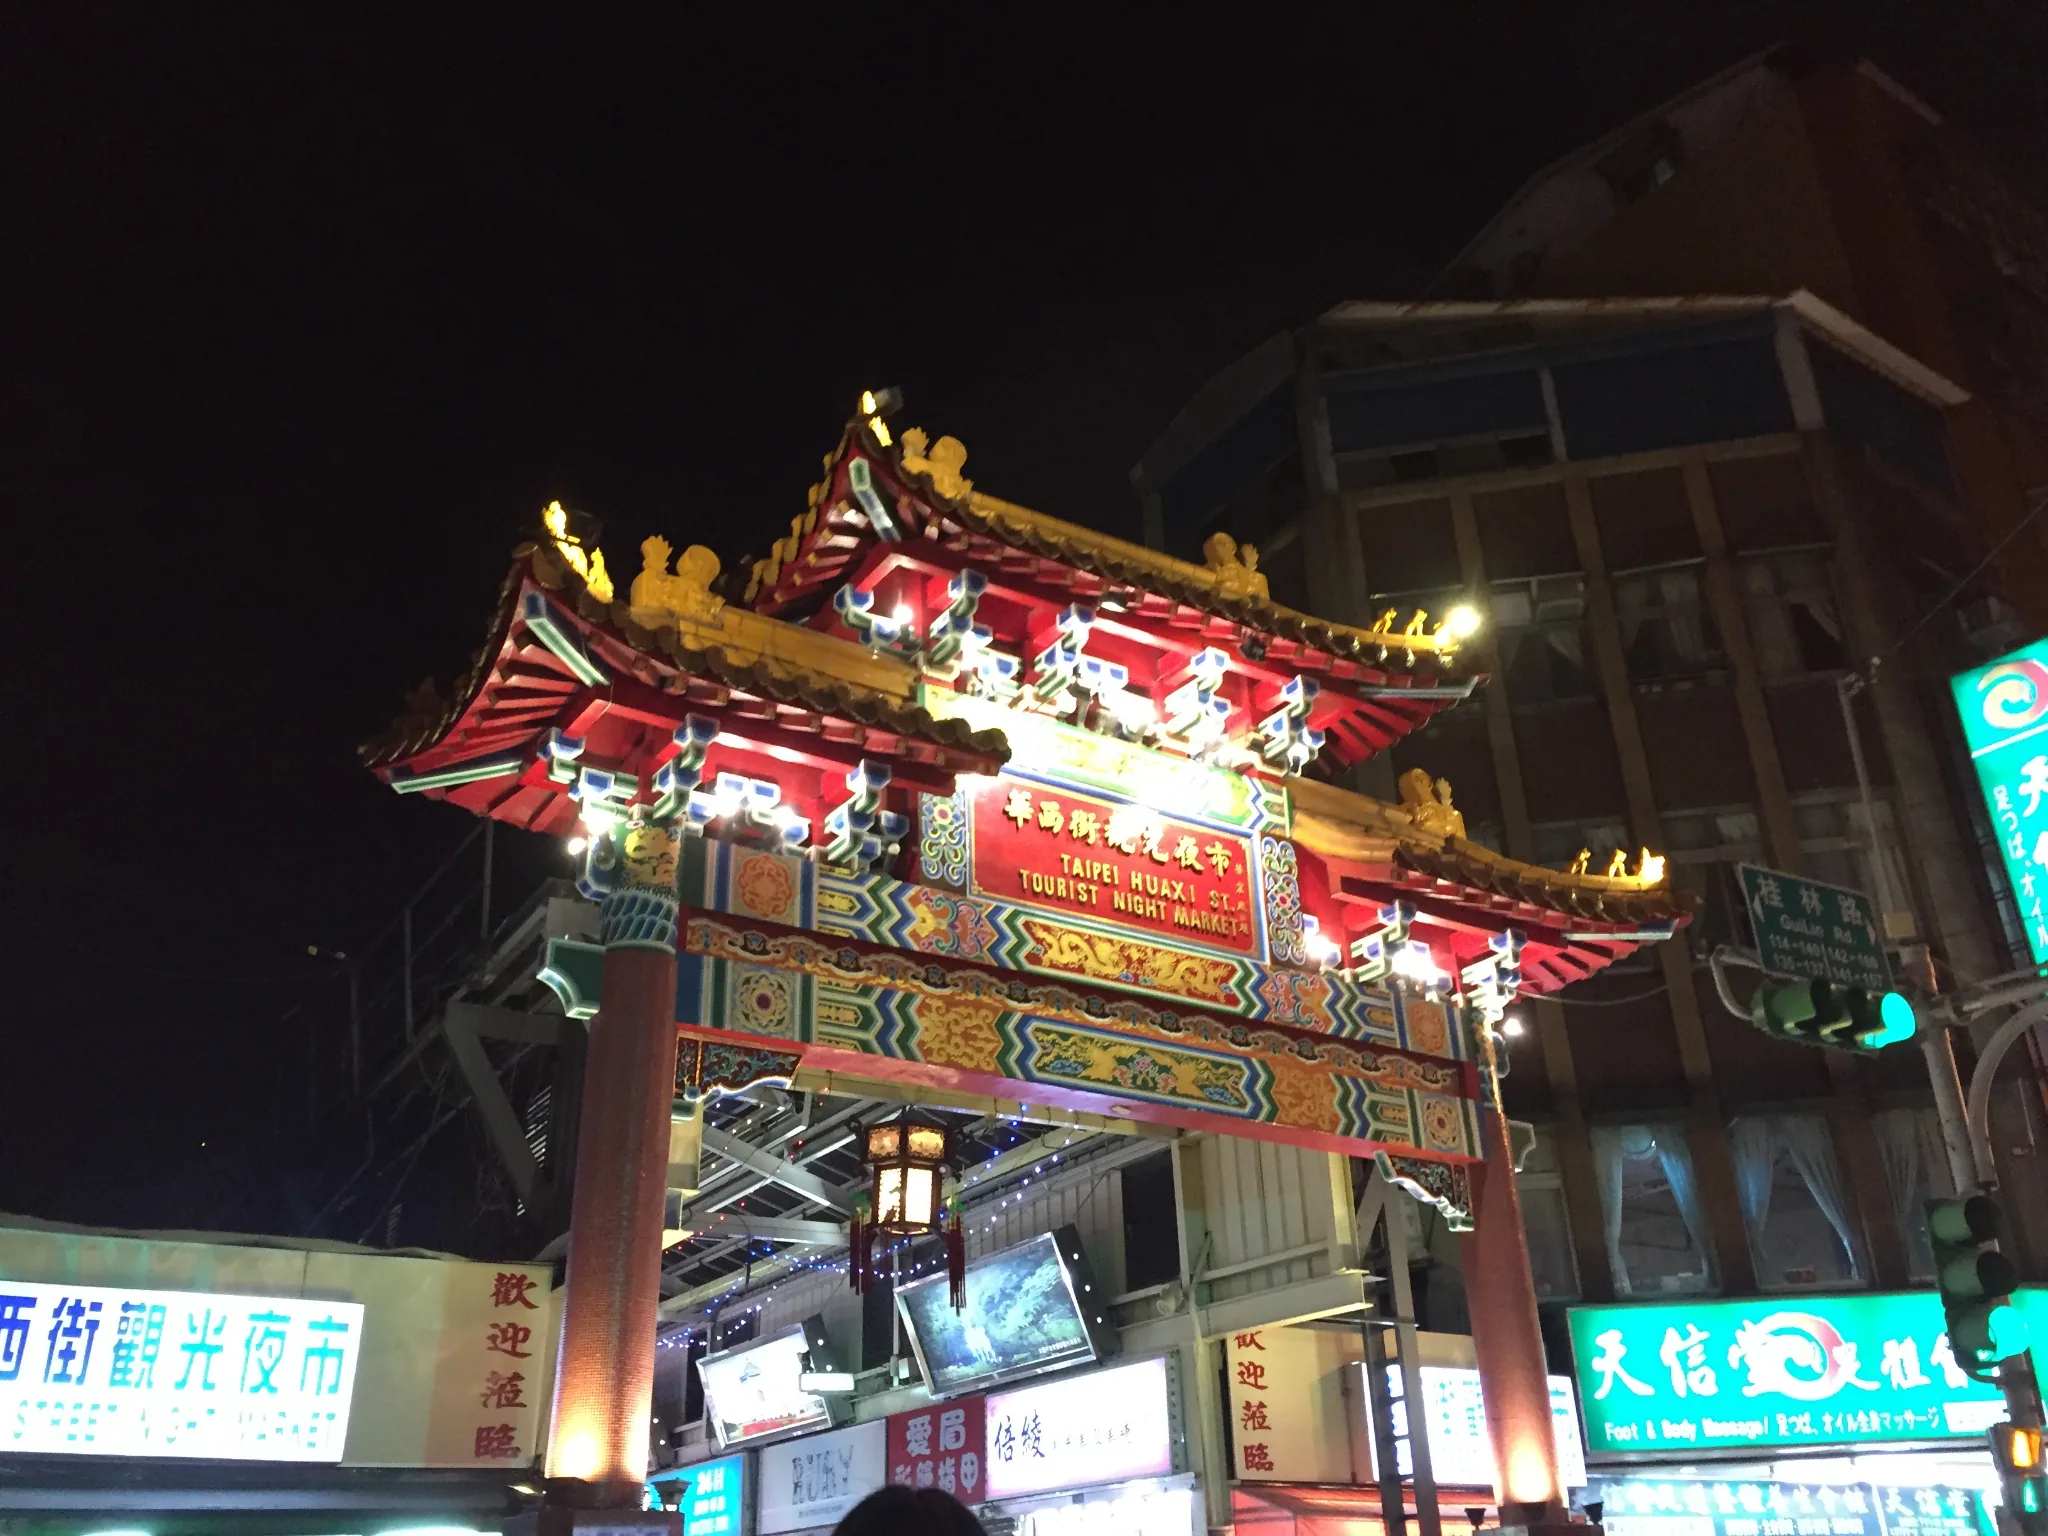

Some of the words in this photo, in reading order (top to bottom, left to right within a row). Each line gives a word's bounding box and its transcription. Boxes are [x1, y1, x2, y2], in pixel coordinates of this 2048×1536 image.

[1019, 868, 1099, 904] TOURIST
[1113, 890, 1166, 921] NIGHT
[1174, 905, 1238, 938] MARKET
[1060, 853, 1119, 885] TAIPEI
[1131, 870, 1195, 903] HUAXI
[1208, 890, 1235, 912] ST.
[1757, 874, 1864, 925] 桂林路
[474, 1272, 540, 1459] 歡迎蒞臨
[1605, 1421, 1639, 1441] Foot
[1646, 1419, 1657, 1440] &
[1661, 1418, 1697, 1442] Body
